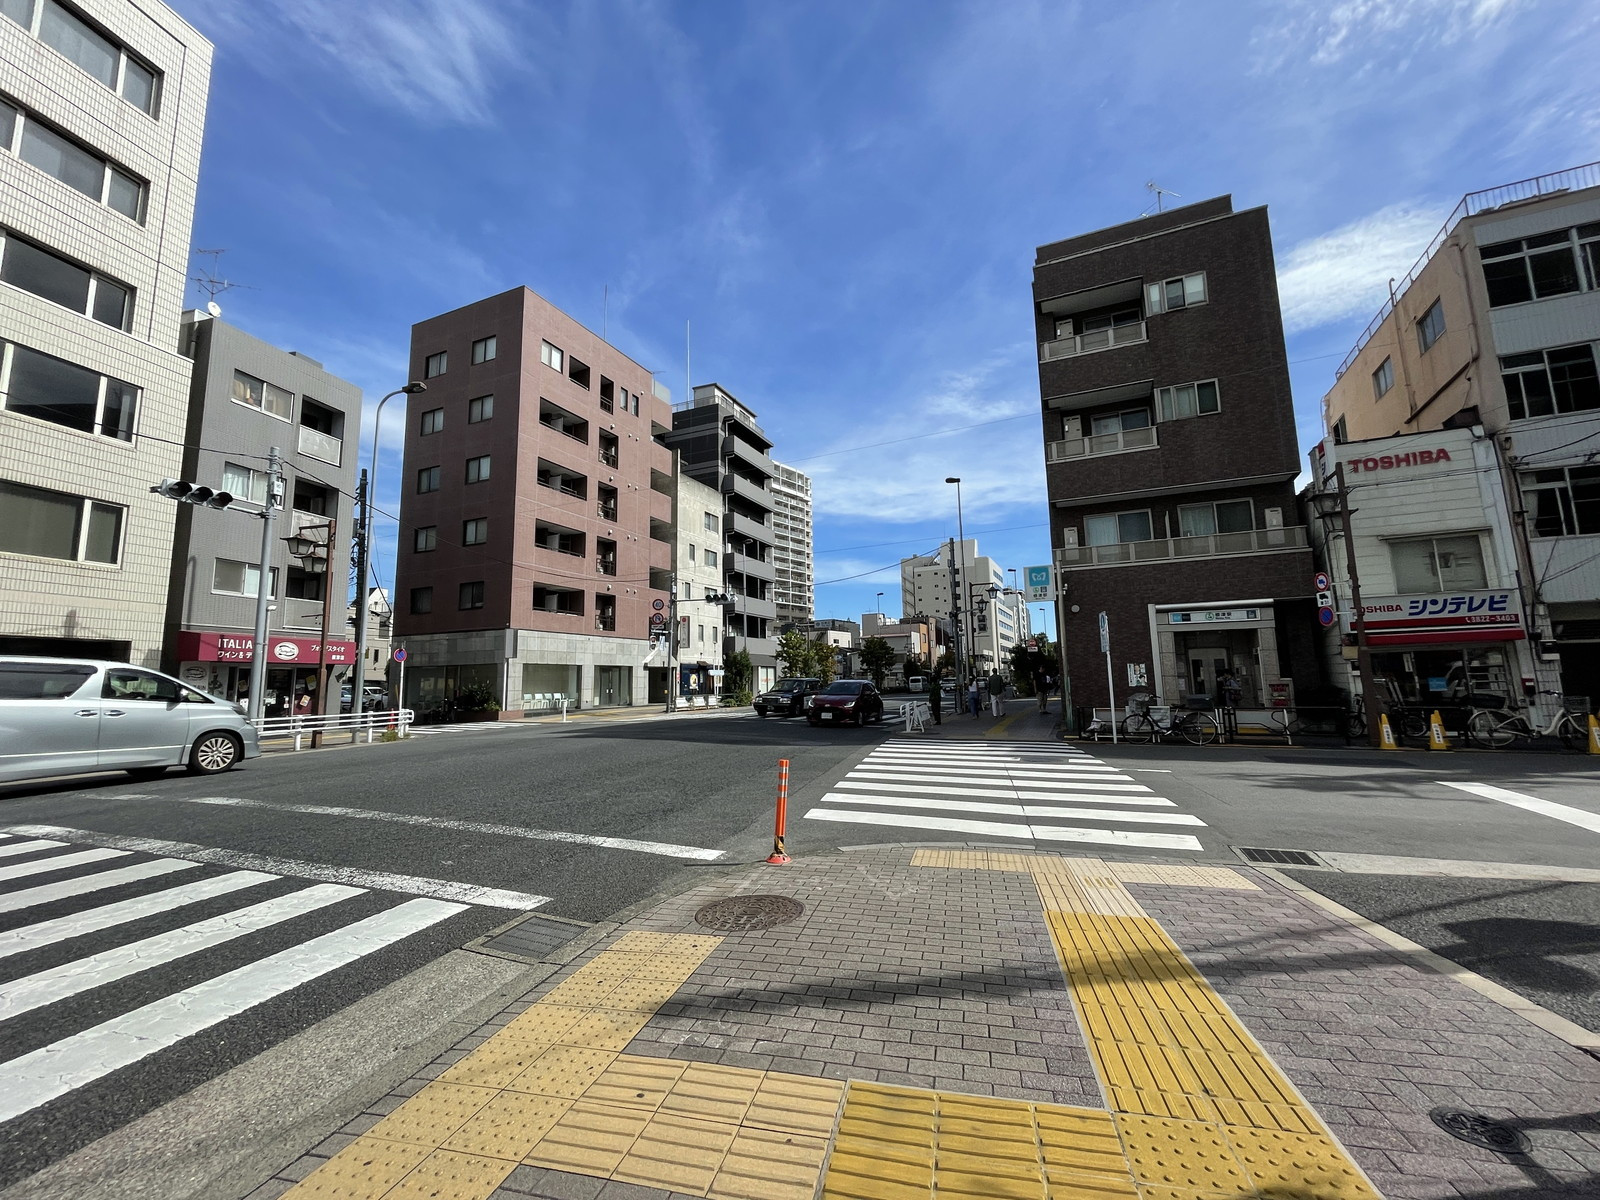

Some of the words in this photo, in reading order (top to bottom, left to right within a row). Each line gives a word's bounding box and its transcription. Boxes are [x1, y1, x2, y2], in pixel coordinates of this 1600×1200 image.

[1347, 448, 1451, 473] TOSHIBA
[1408, 594, 1508, 616] シンテレビ
